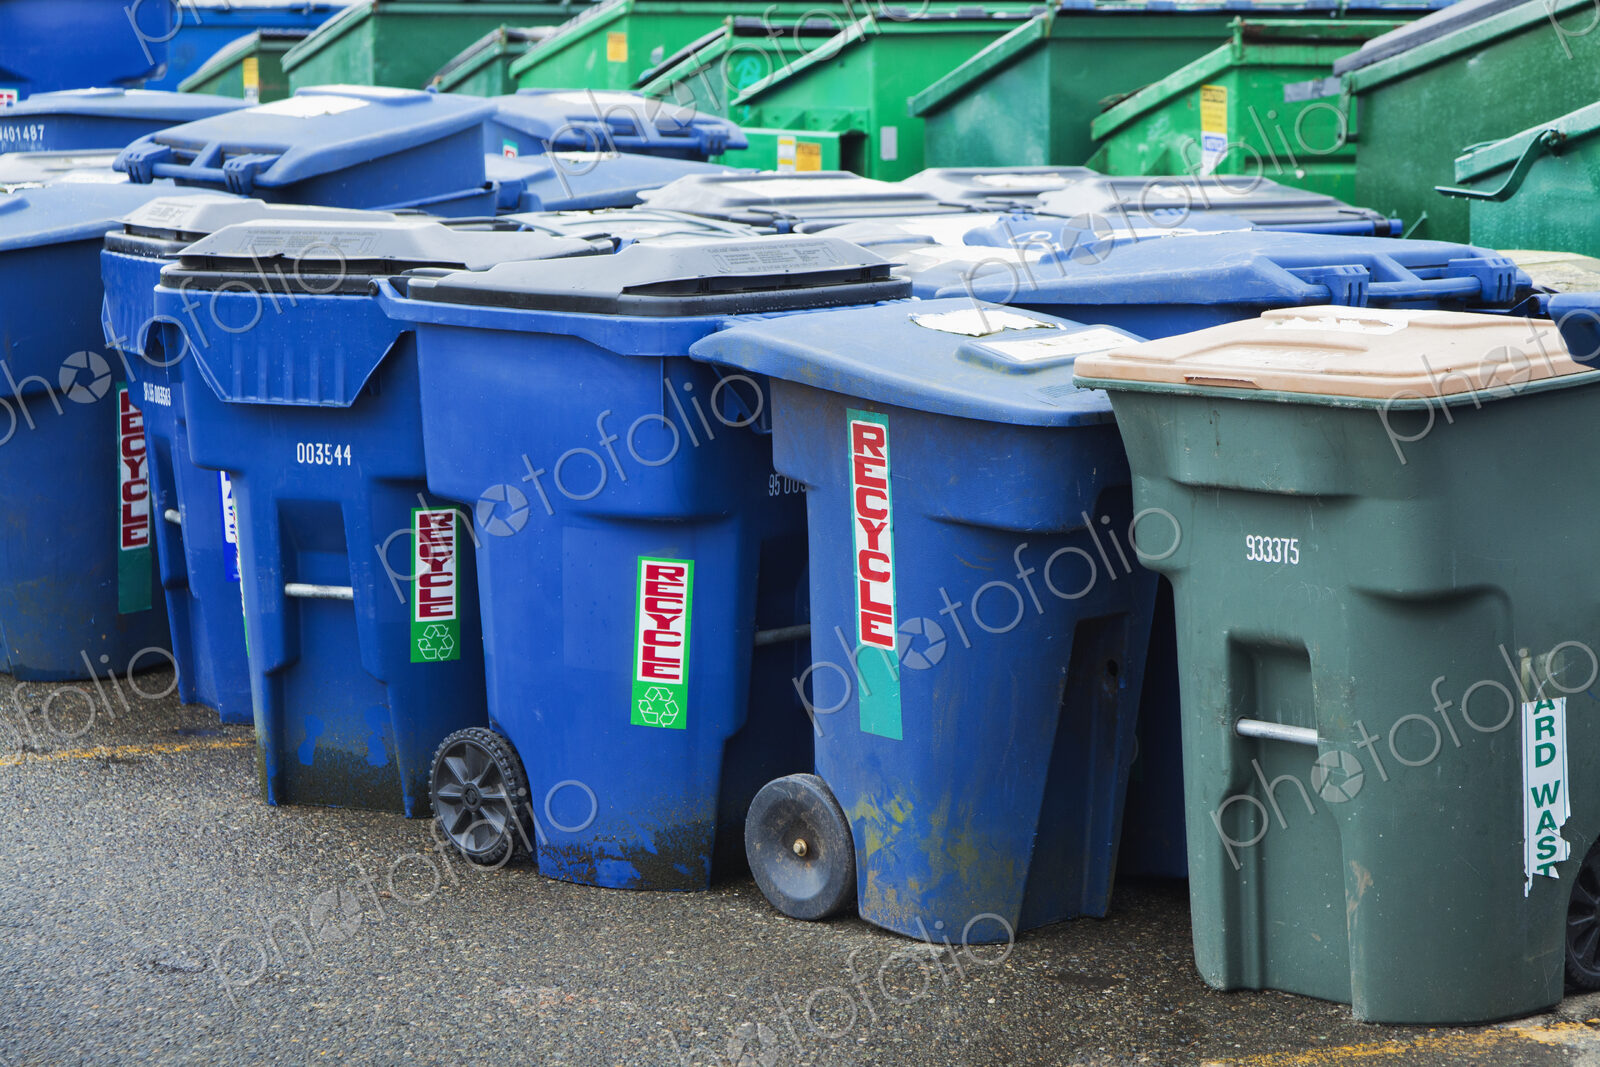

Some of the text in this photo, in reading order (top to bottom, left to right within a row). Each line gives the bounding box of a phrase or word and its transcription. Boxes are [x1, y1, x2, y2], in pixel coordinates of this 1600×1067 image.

[297, 442, 352, 466] 003544
[768, 473, 781, 496] 95
[419, 512, 453, 618] RECYCLE
[852, 422, 893, 647] RECYCLE
[1246, 534, 1300, 565] 933375
[641, 564, 685, 680] RECYCLE
